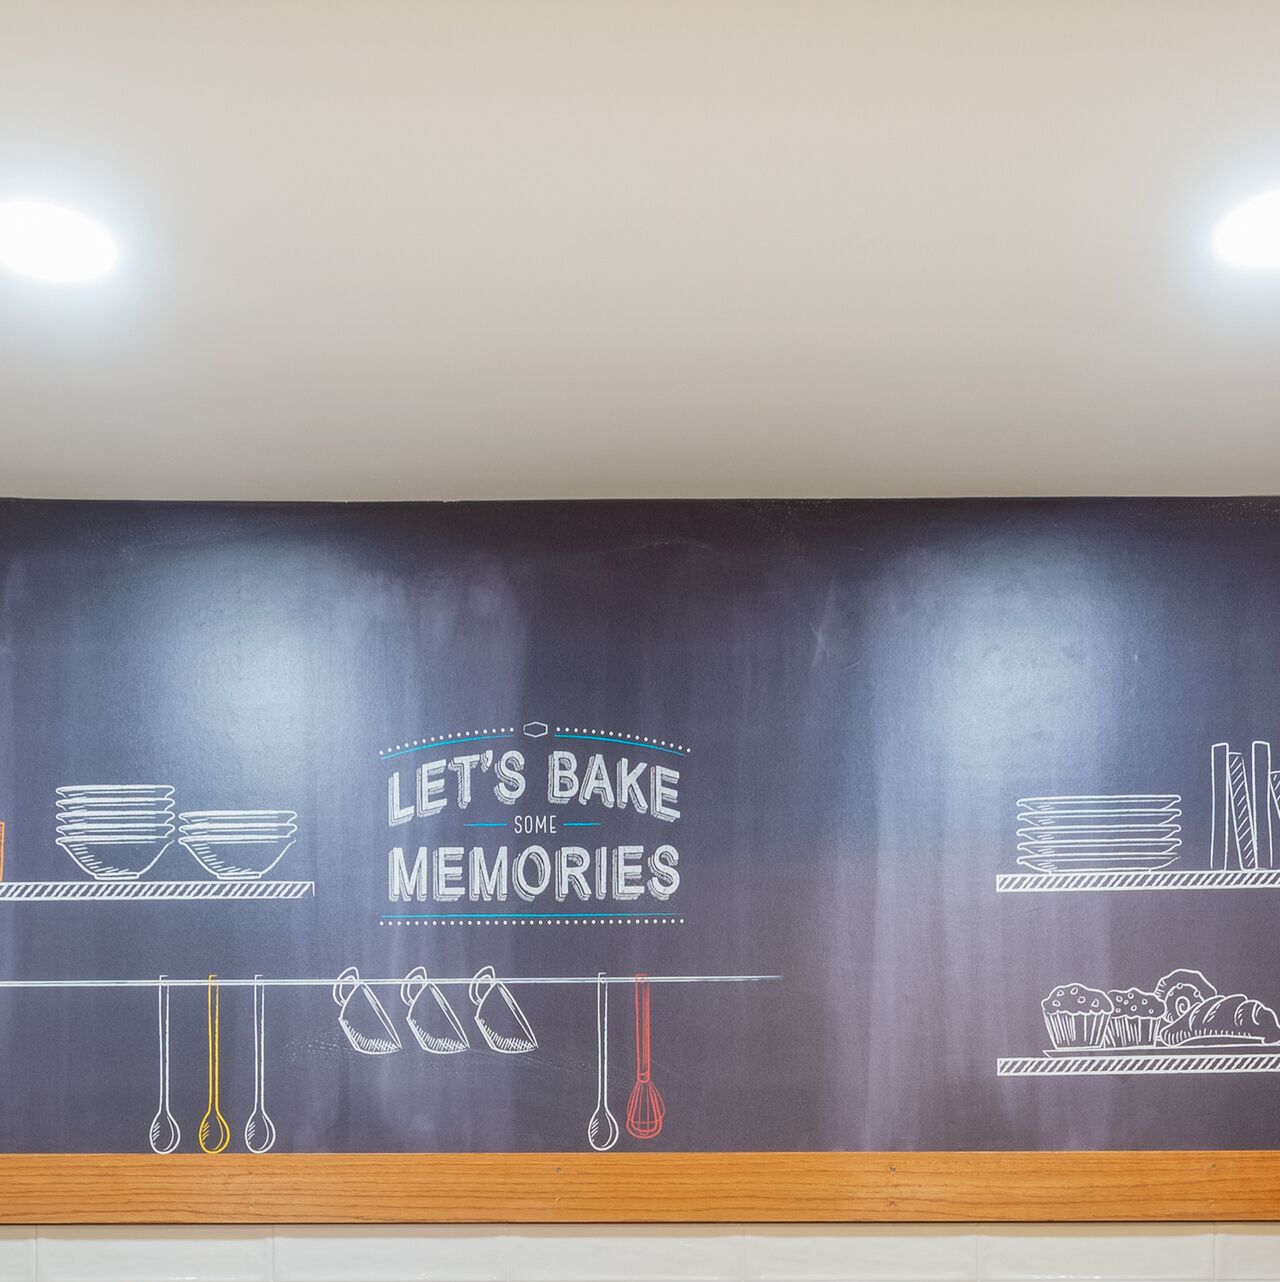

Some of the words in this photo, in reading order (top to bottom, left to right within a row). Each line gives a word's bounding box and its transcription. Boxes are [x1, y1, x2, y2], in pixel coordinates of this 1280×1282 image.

[388, 750, 526, 826] LET'S
[548, 750, 681, 822] BAKE
[514, 815, 557, 834] SOME
[388, 845, 681, 902] MEMORIES
